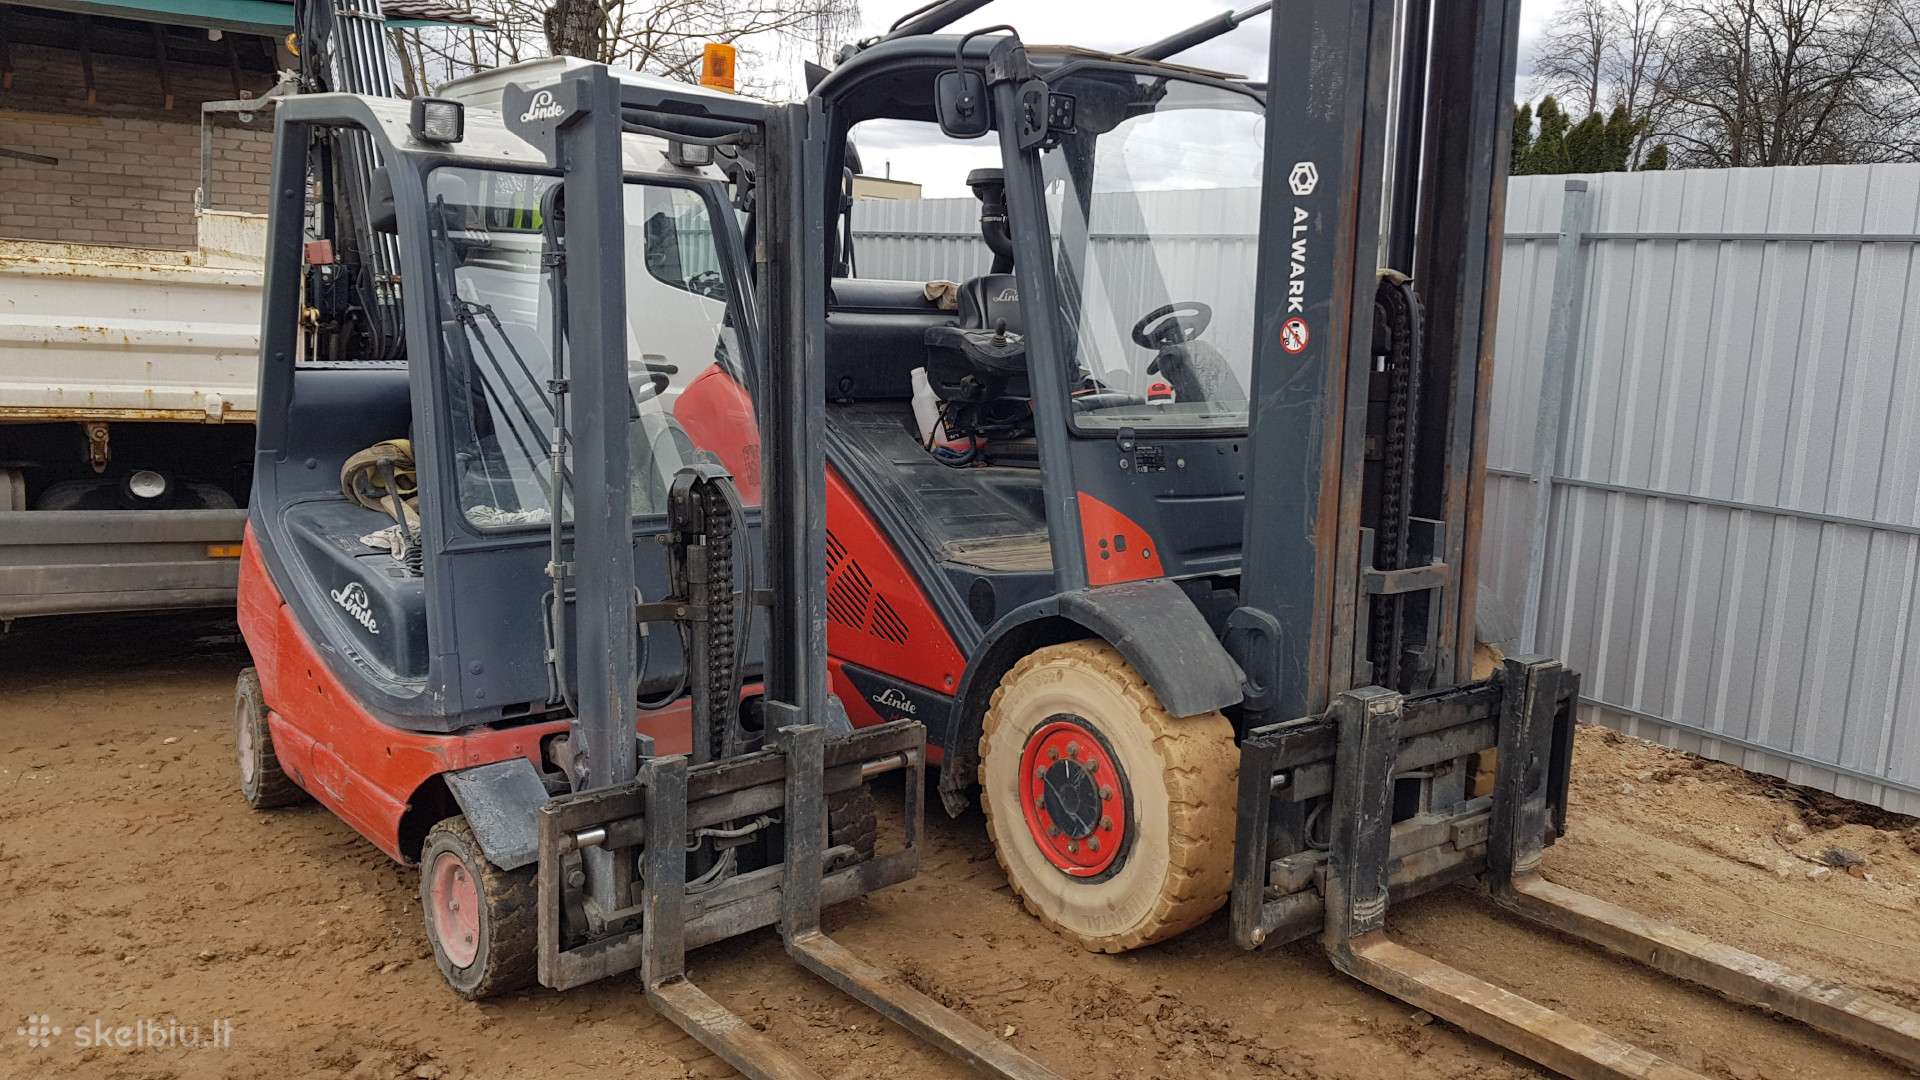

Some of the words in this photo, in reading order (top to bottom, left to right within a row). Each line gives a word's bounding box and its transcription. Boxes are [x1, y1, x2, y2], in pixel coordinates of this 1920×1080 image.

[521, 90, 565, 122] Linde
[1288, 206, 1309, 313] ALWARK
[331, 582, 379, 634] Linde
[873, 688, 917, 714] Linde
